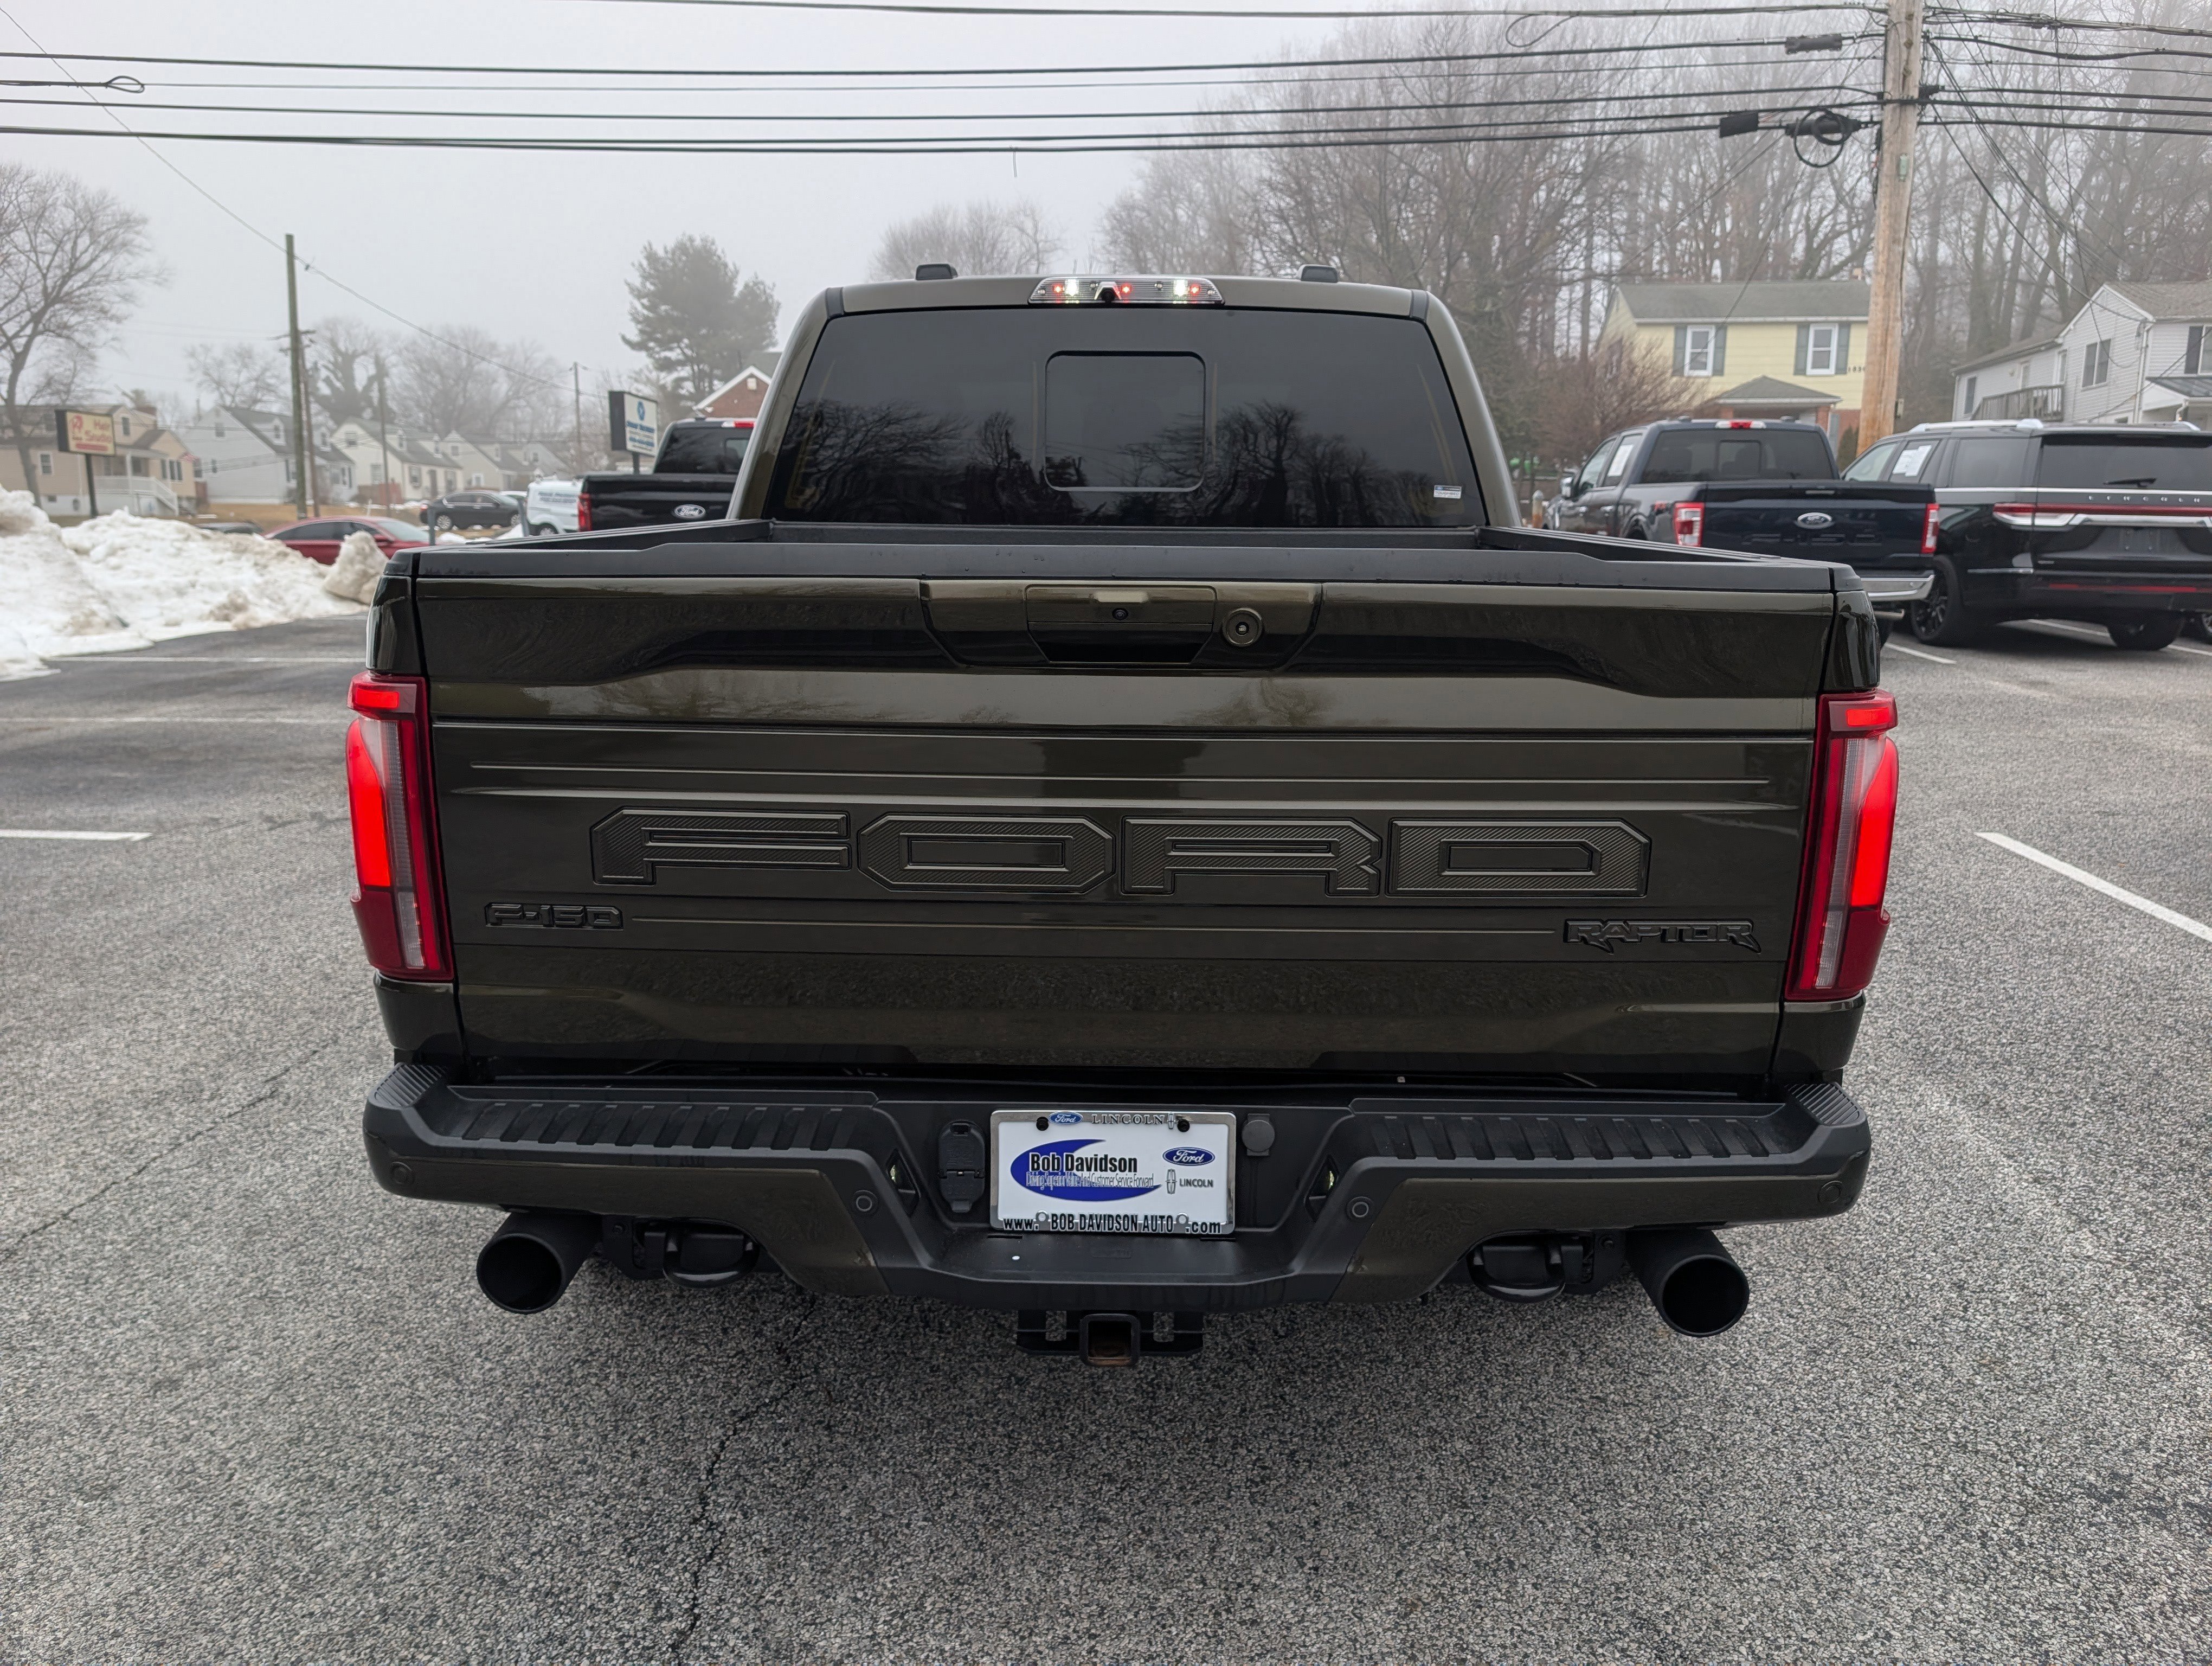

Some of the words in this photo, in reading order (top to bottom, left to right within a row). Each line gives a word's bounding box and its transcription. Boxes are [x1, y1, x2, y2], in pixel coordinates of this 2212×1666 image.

[589, 806, 1651, 897] FORD
[484, 902, 623, 930] F-150
[1563, 919, 1761, 955] RAPTOR
[1054, 1113, 1076, 1123] Ford
[1091, 1113, 1165, 1125] LINCOLN
[1030, 1152, 1061, 1171] Bob
[1065, 1153, 1138, 1172] Davidson
[1173, 1149, 1205, 1163] Ford
[1116, 1172, 1133, 1188] Service
[1133, 1173, 1154, 1188] Forward
[1179, 1178, 1214, 1188] LINCOLN
[1003, 1218, 1039, 1231] www.
[1051, 1213, 1075, 1231] BOB
[1078, 1213, 1138, 1232] DAVIDSON
[1142, 1214, 1174, 1233] AUTO
[1185, 1221, 1221, 1234] .com
